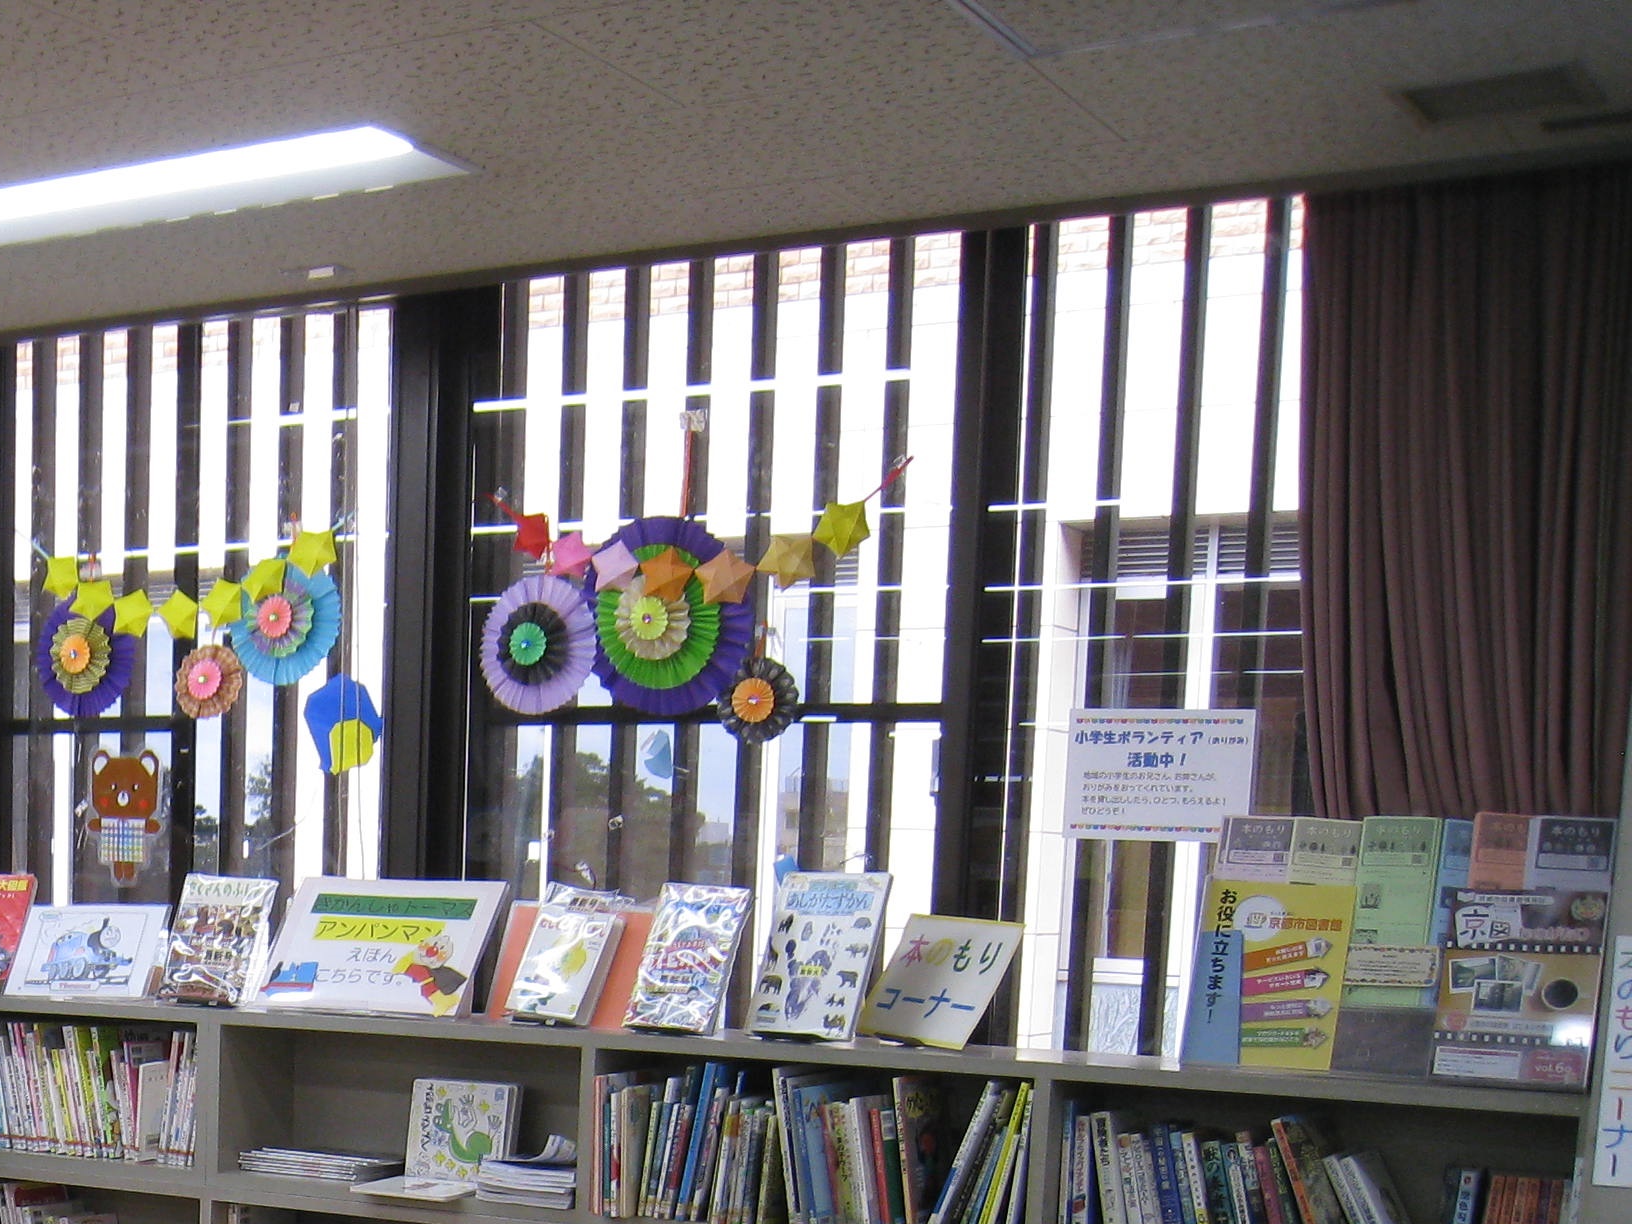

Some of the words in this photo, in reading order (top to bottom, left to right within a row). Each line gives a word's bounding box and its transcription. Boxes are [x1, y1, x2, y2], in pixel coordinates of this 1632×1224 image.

[1075, 731, 1204, 745] 小学生ボランティア
[1127, 752, 1187, 768] 活動中！
[314, 920, 442, 943] アンパンマン
[346, 947, 396, 963] えほん
[901, 934, 1003, 975] 本のもり
[1206, 888, 1238, 1024] お役に立ちます！
[315, 968, 403, 987] こちらです。
[876, 987, 976, 1018] コーナー
